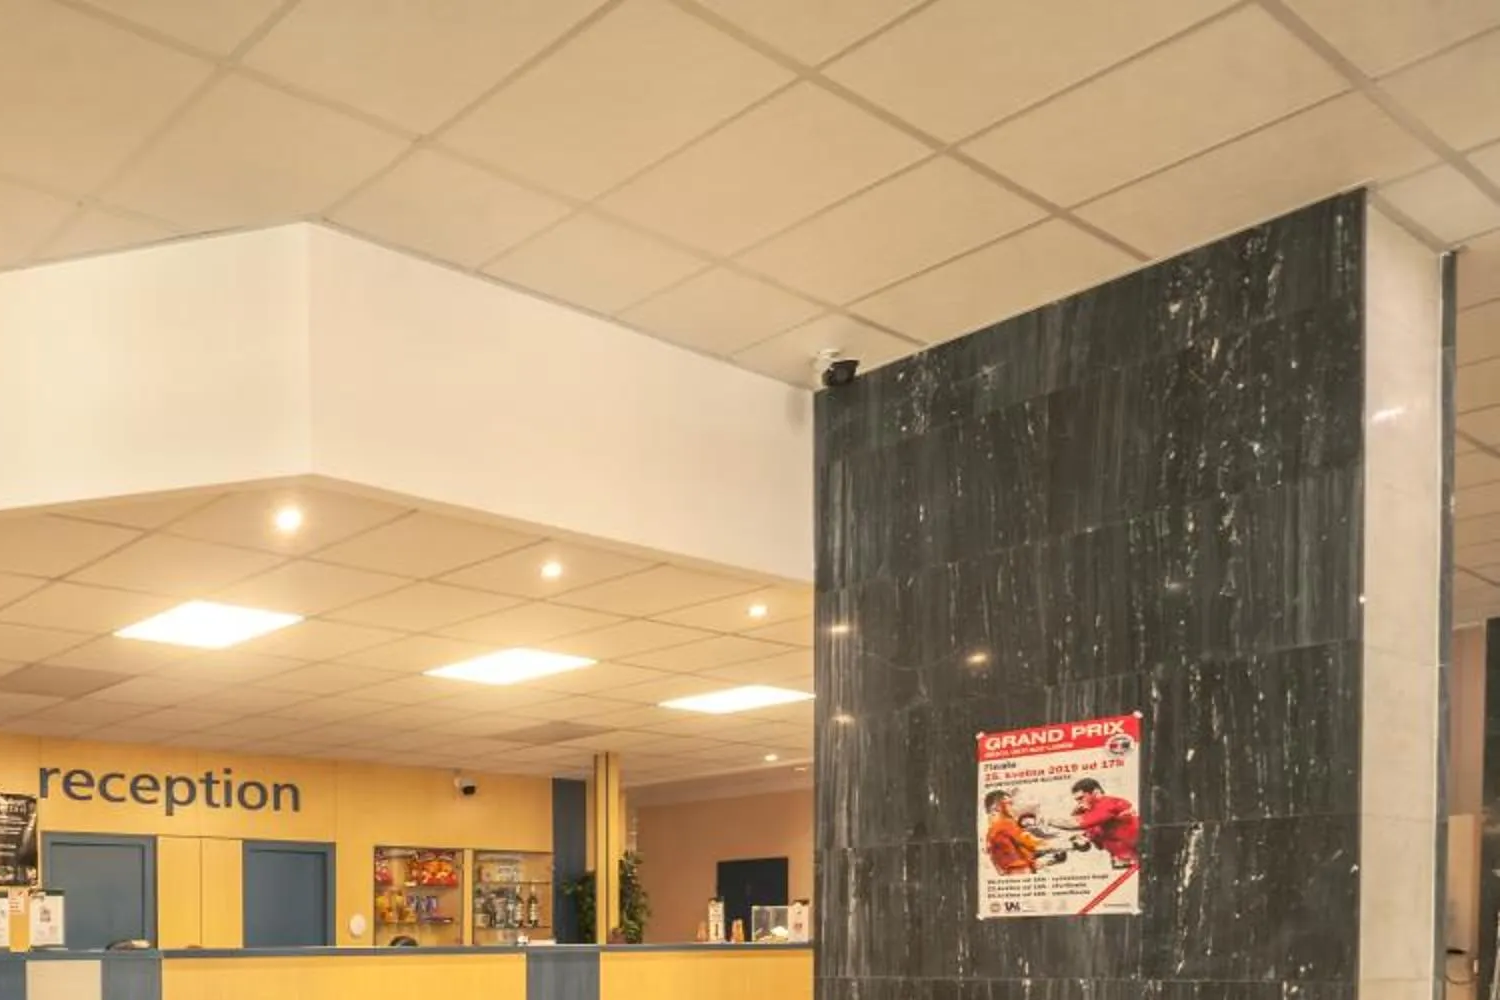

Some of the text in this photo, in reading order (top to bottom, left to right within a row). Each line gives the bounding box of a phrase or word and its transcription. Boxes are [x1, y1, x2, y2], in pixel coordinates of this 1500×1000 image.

[985, 729, 1064, 751] GRAND
[1071, 720, 1125, 739] PRIX
[1048, 763, 1079, 775] 2019
[38, 766, 301, 817] reception
